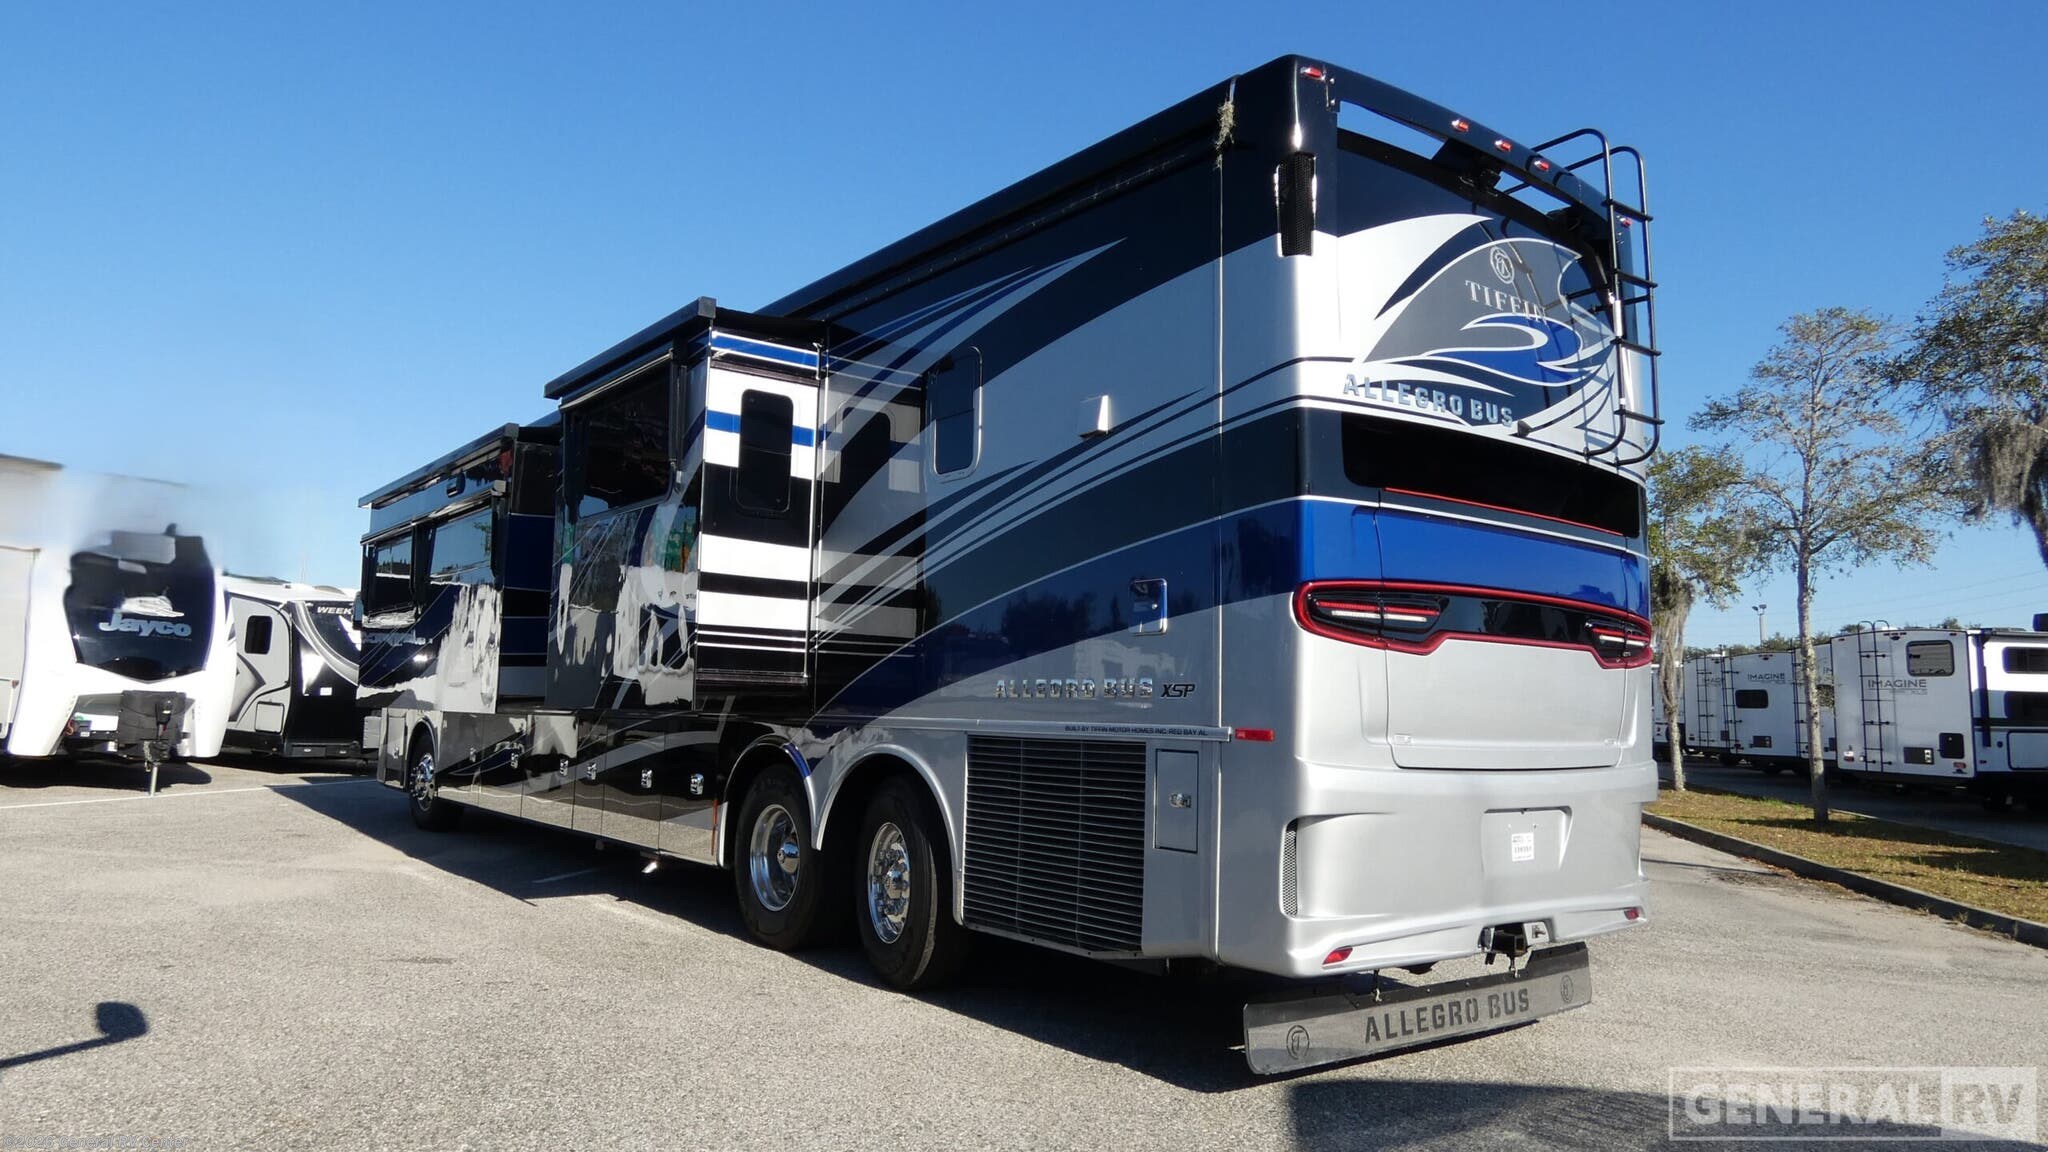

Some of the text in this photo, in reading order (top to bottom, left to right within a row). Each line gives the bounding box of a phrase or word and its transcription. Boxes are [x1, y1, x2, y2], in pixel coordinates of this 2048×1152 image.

[1465, 280, 1547, 325] TIFFIN
[1343, 373, 1513, 428] ALLEGRO BUS
[98, 608, 192, 637] Jayco
[995, 678, 1196, 699] ALLEGRO BUS XSP
[1747, 672, 1785, 681] IMAGINE
[1867, 679, 1927, 688] IMAGINE
[1365, 988, 1530, 1044] ALLEGRO BUS
